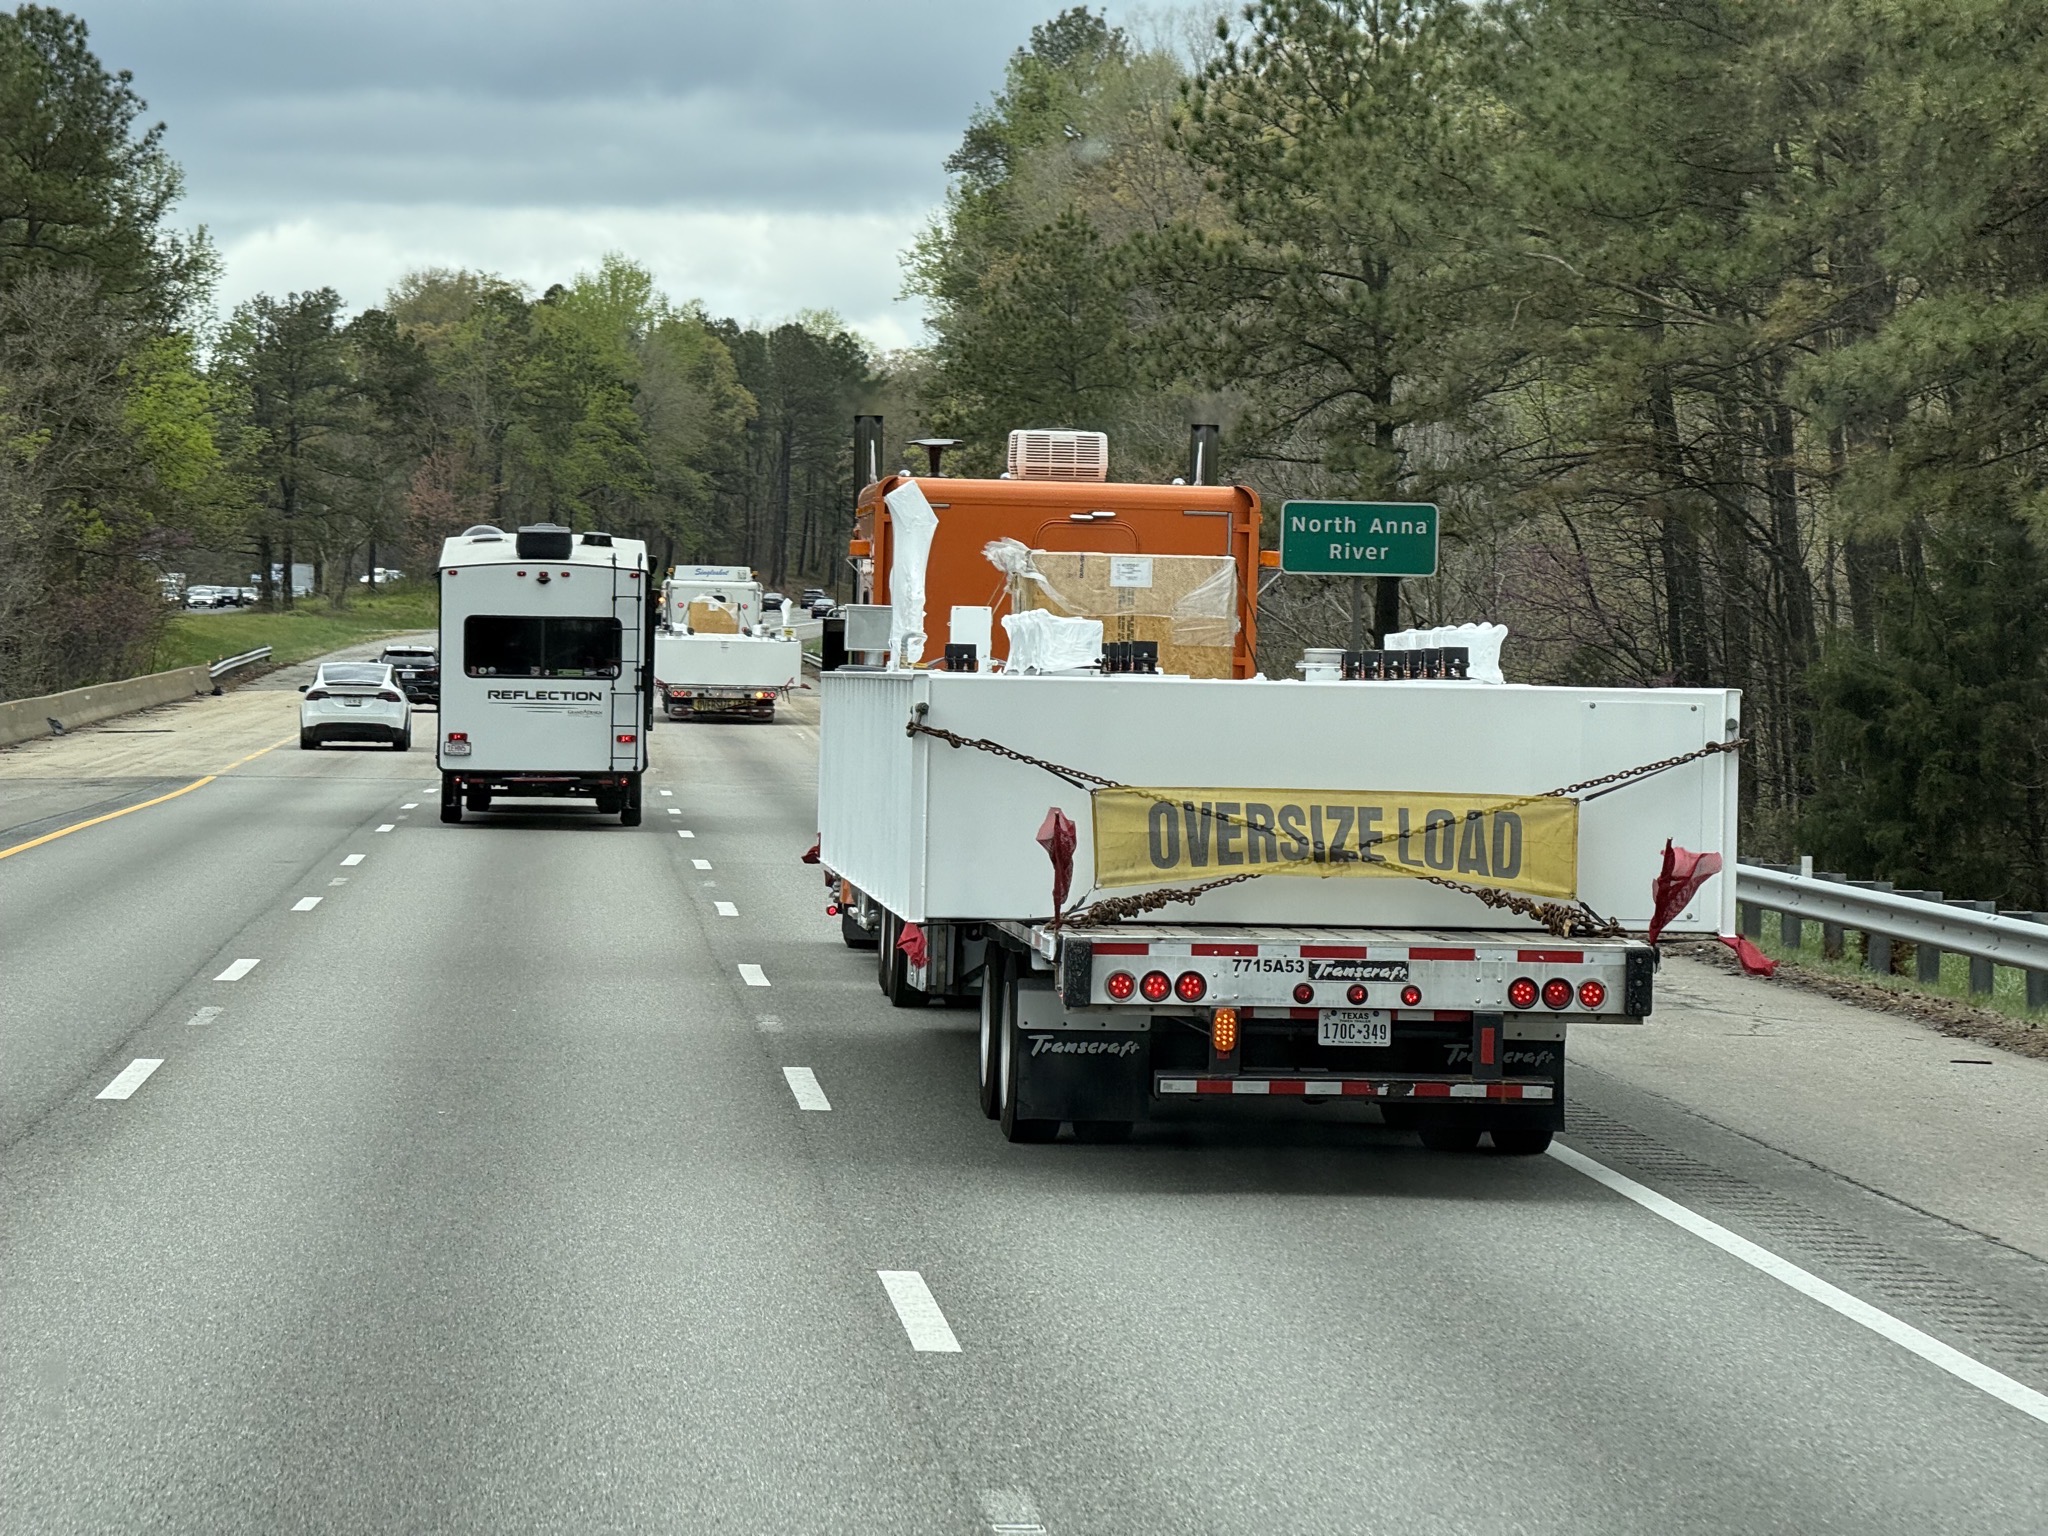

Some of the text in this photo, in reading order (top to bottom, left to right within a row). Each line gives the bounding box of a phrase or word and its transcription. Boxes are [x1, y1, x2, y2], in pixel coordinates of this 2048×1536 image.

[1291, 516, 1427, 534] North Anna
[1329, 543, 1389, 560] River
[487, 690, 602, 701] REFLECTION
[1147, 799, 1523, 880] OVERSIZE LOAD
[1232, 959, 1408, 981] 7715A53 Transcraft
[1341, 1012, 1369, 1020] TEXAS
[1027, 1034, 1140, 1058] Transcraft
